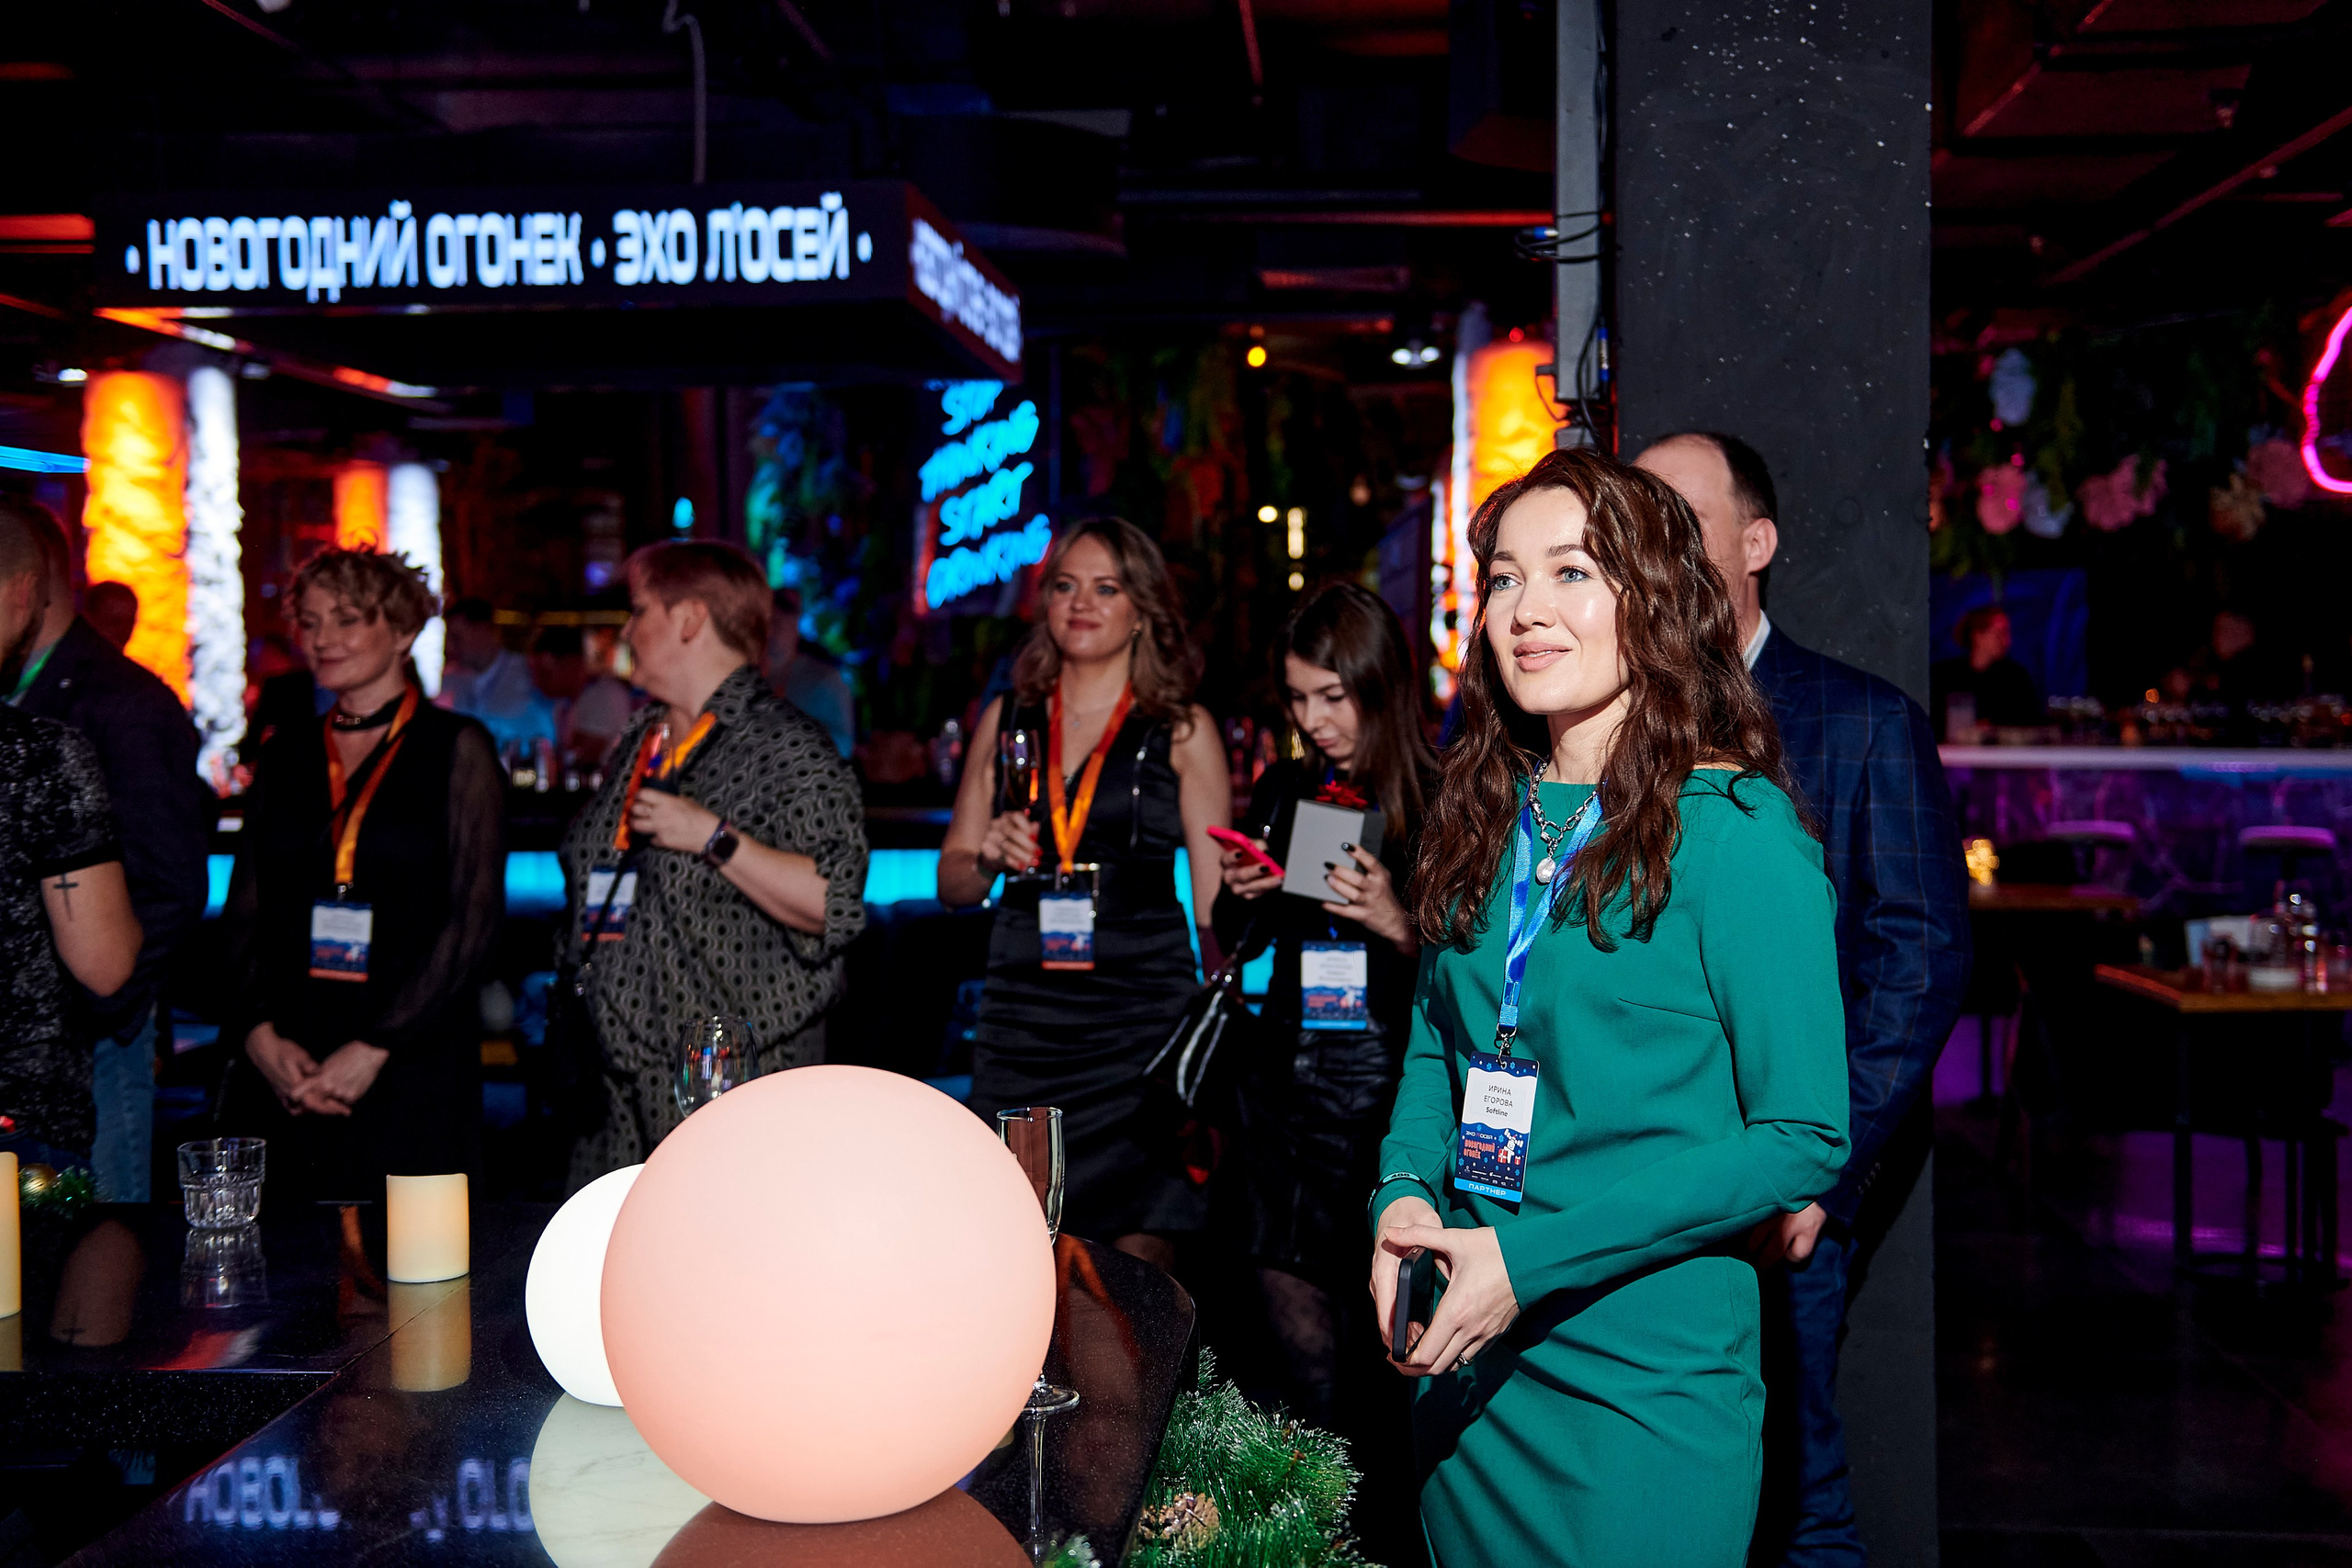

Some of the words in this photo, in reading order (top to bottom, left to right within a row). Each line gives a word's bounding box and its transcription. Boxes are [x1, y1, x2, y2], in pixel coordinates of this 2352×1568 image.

[147, 198, 419, 304] НОВОГОДНИЙ
[425, 211, 584, 288] ОГОНЕК
[612, 208, 698, 287] ЭХО
[704, 191, 851, 284] ЛОСЕЙ
[1488, 1084, 1511, 1096] ИРИНА
[1484, 1095, 1513, 1107] ЕГОРОВА
[1486, 1106, 1509, 1117] Softline
[1468, 1183, 1507, 1196] ПАРТНЕР
